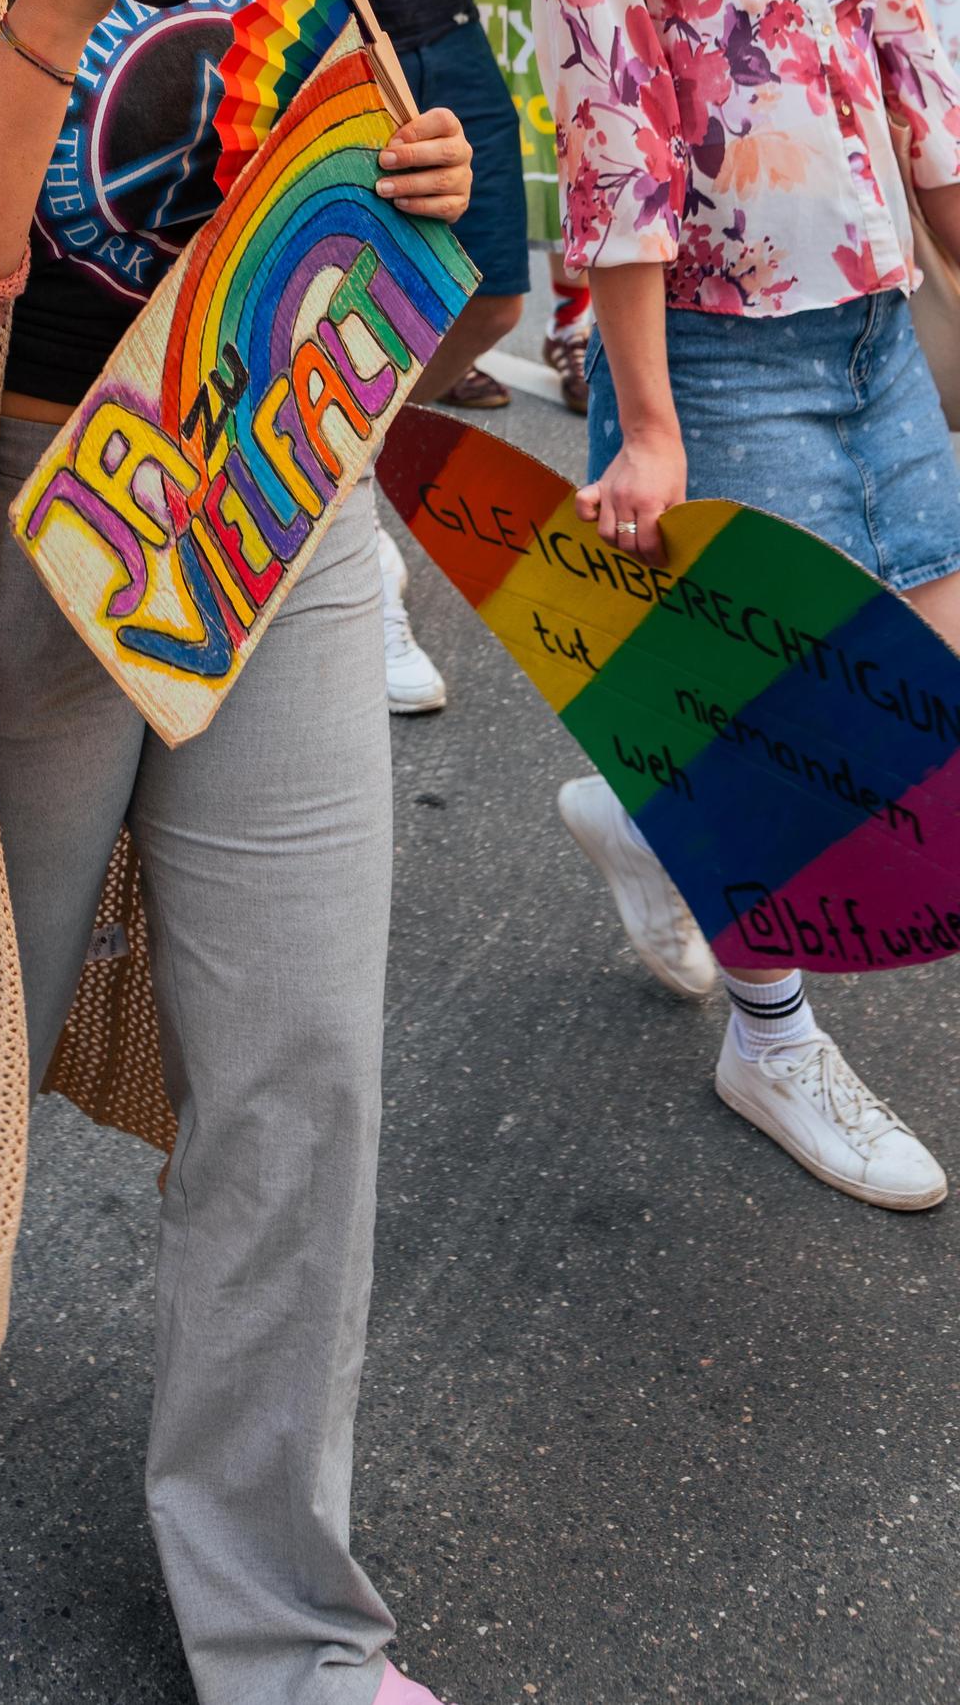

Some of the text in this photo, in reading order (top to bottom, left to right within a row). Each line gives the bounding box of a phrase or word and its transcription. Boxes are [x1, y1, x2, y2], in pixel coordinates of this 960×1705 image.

[25, 343, 252, 617] JA ZU
[116, 240, 412, 679] VIELFALT
[533, 611, 924, 844] tut niemandem
[613, 735, 693, 801] weh
